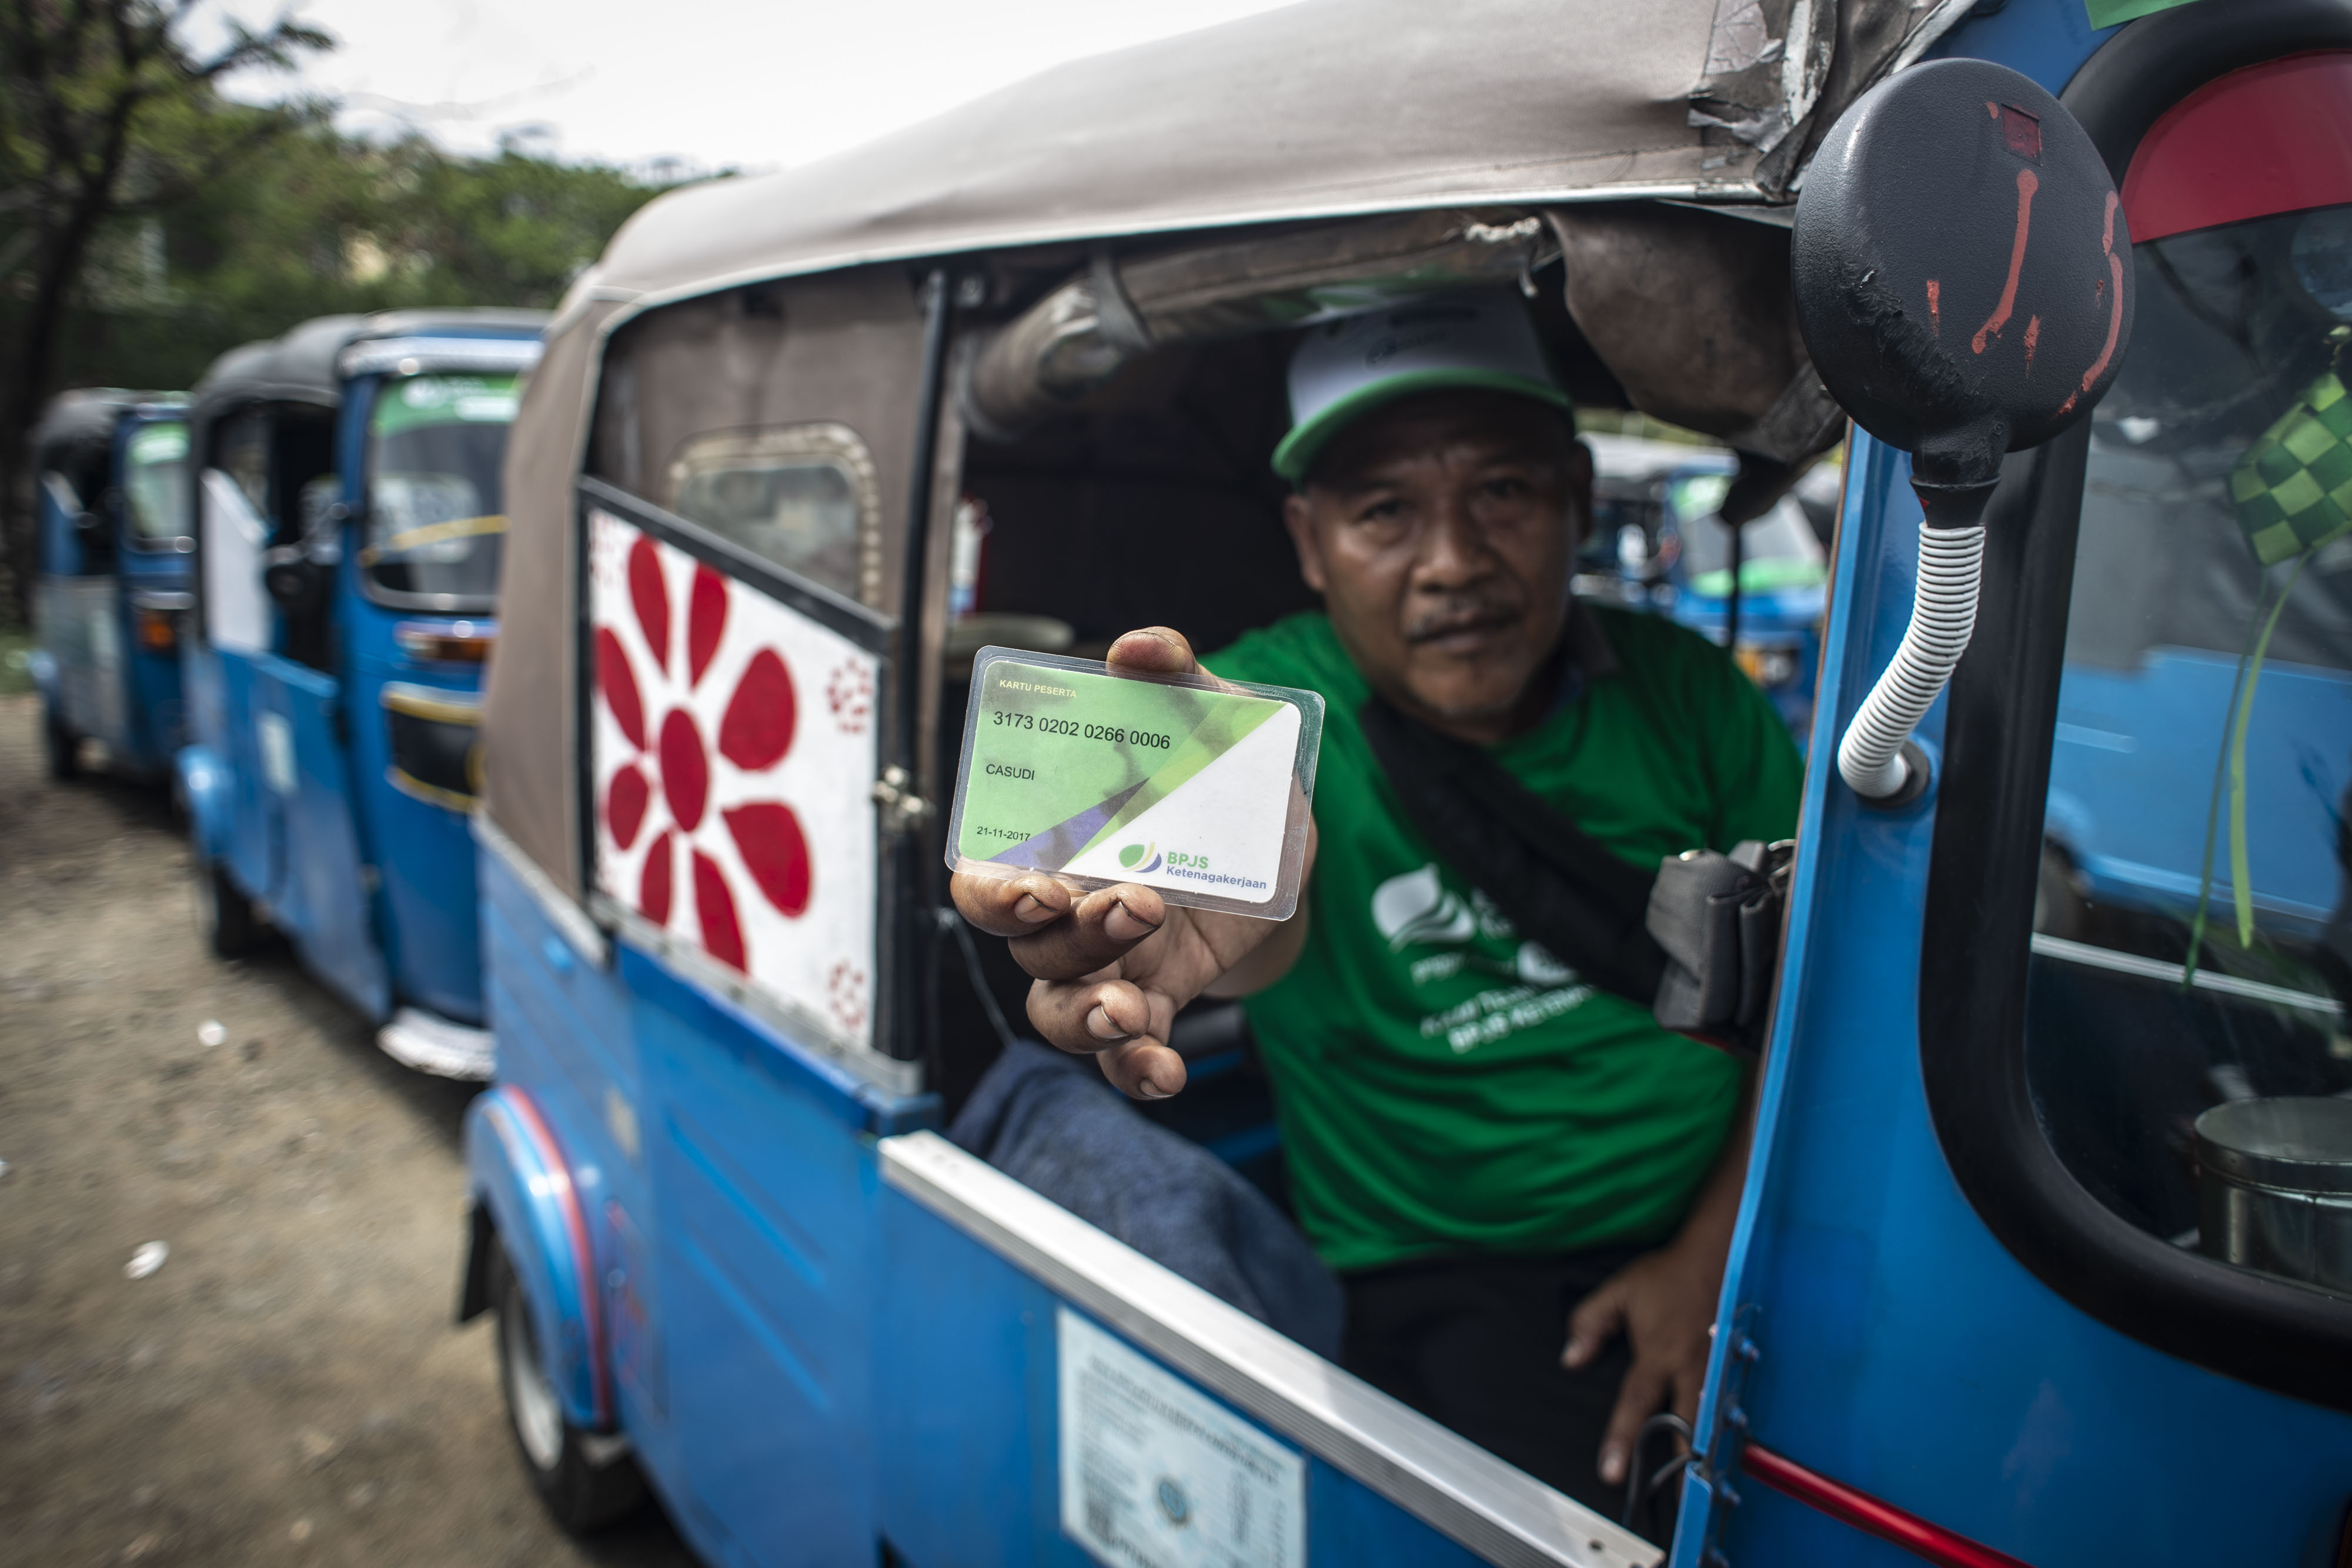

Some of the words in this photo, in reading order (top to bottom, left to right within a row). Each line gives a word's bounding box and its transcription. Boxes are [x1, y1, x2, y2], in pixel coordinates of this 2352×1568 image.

[1000, 679, 1031, 691] KARTU
[1034, 684, 1077, 698] PESERTA
[993, 711, 1034, 730] 3173
[1039, 717, 1080, 736] 0202
[1084, 724, 1125, 743] 0266
[1130, 730, 1171, 749] 0006
[985, 764, 1035, 780] CASUDI
[976, 826, 1031, 841] 21-11-2017
[1167, 851, 1209, 870] BPJS
[1166, 865, 1267, 890] Ketenagakerjaan
